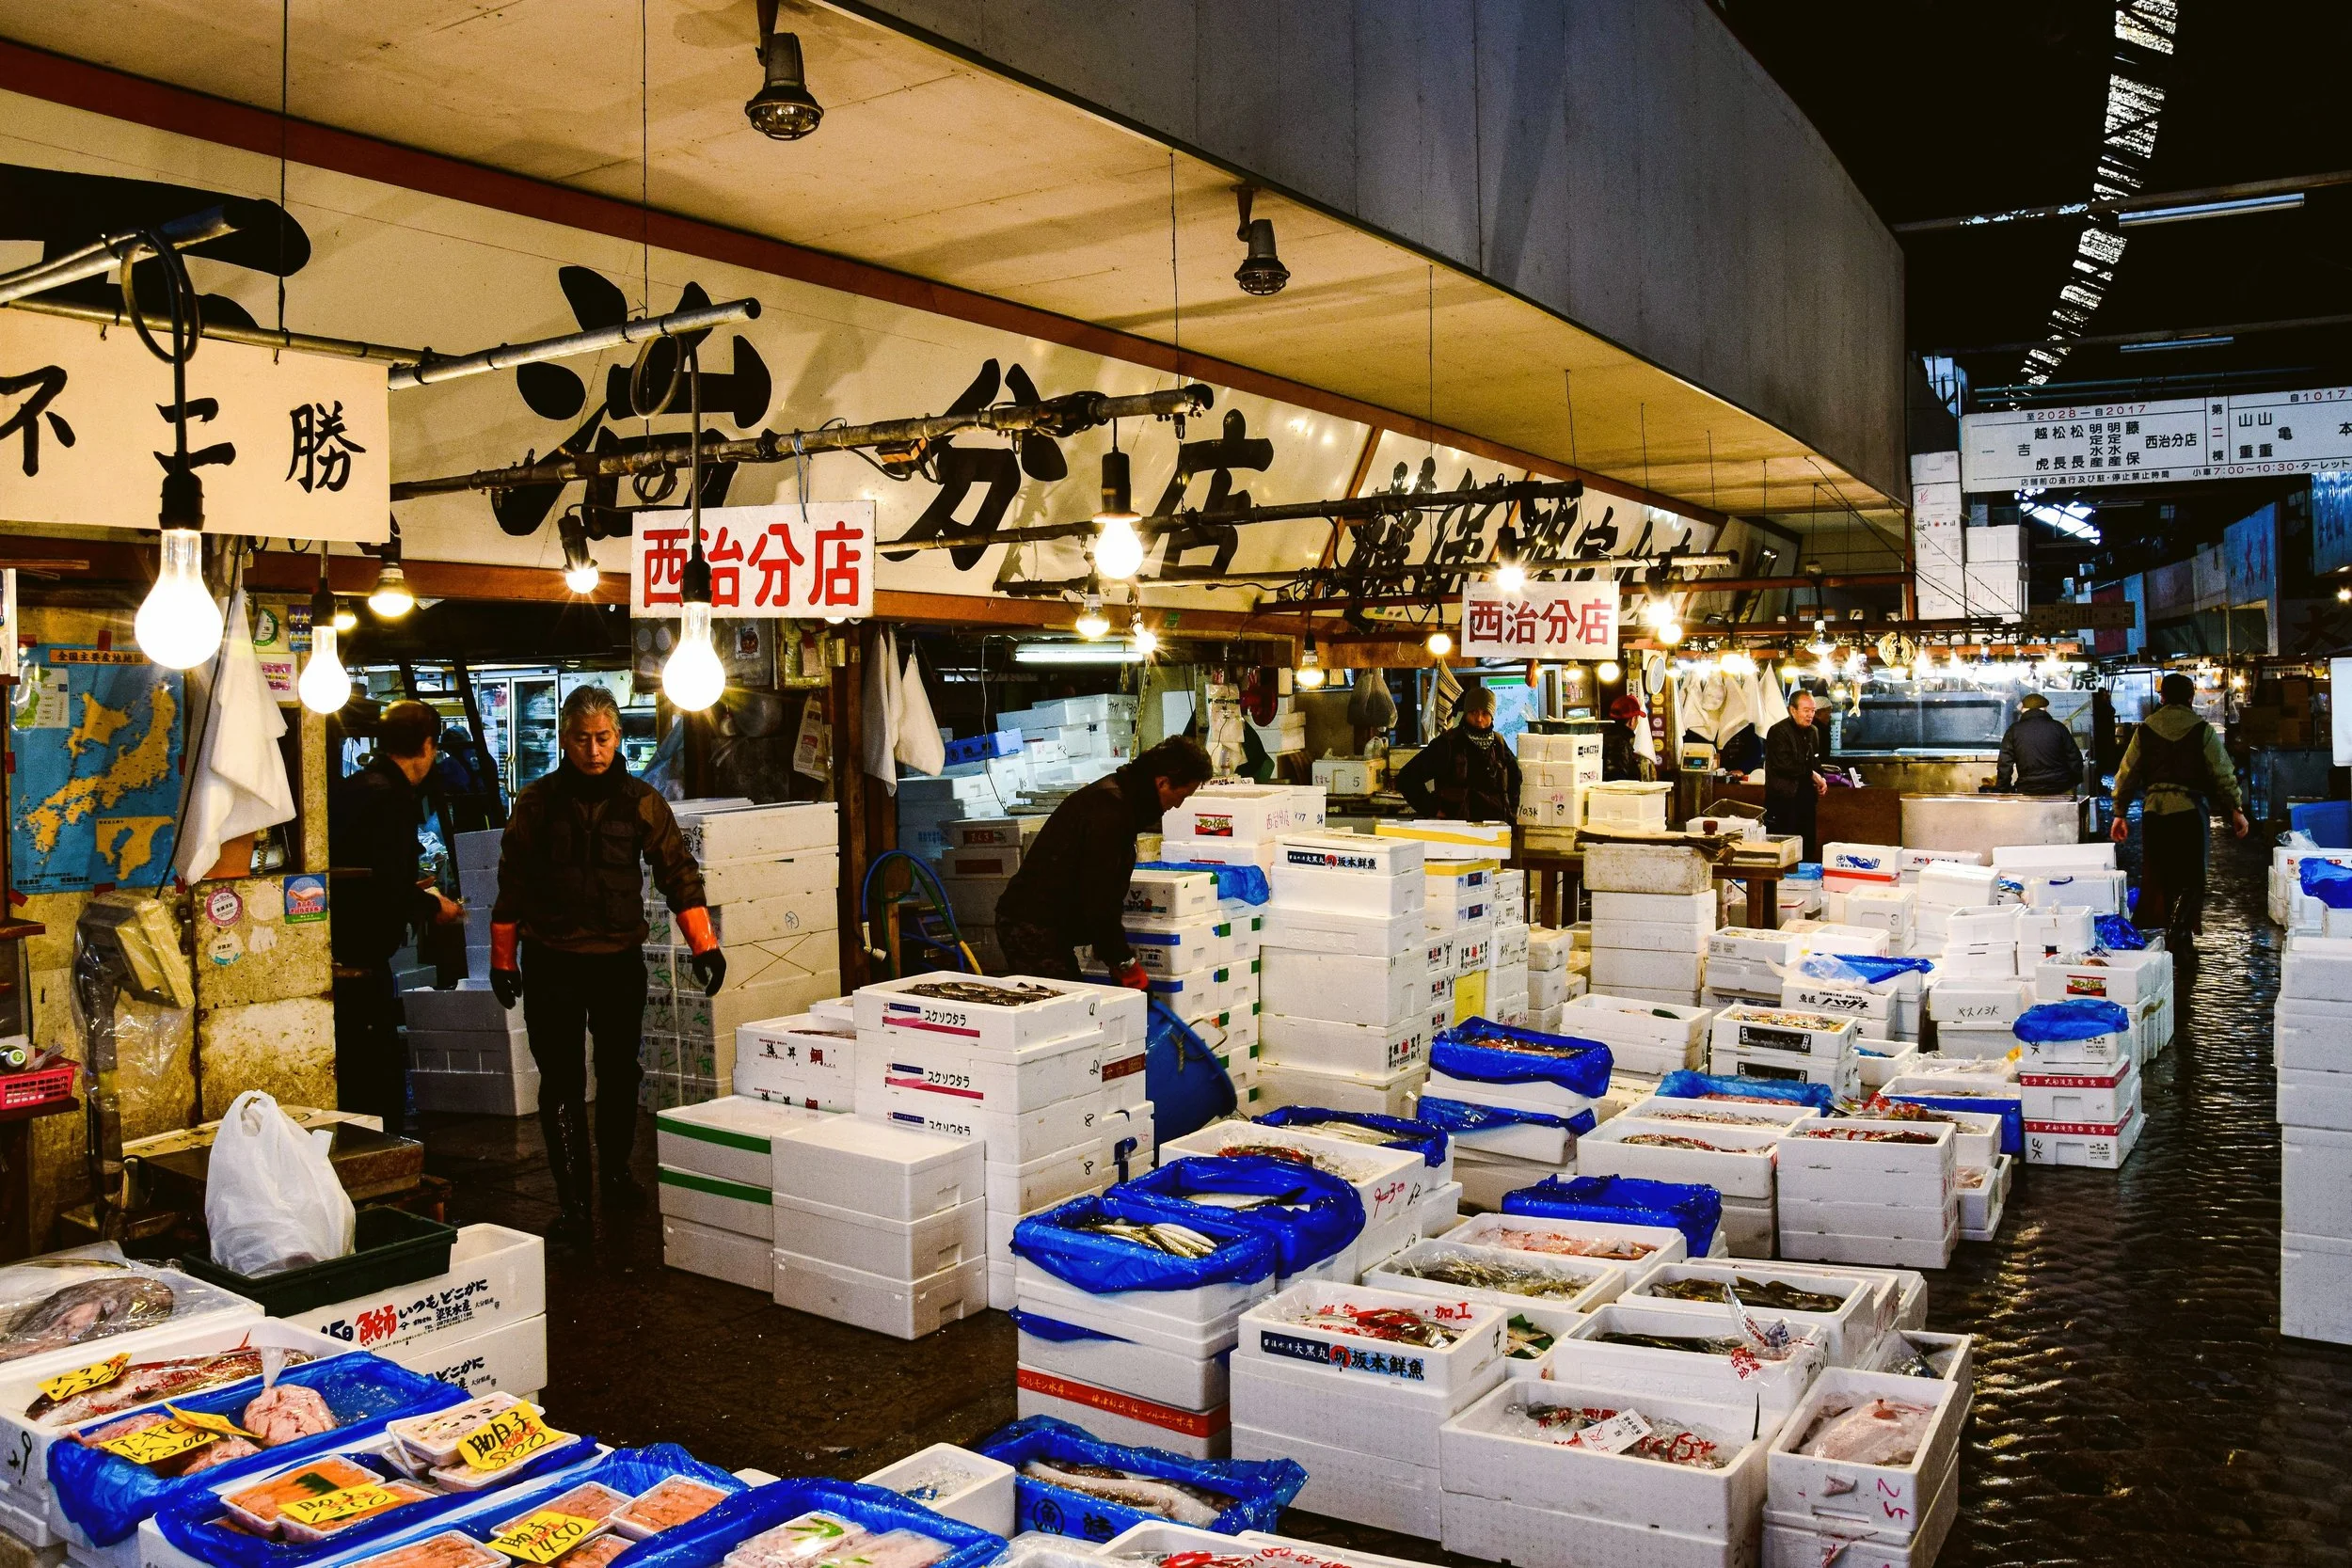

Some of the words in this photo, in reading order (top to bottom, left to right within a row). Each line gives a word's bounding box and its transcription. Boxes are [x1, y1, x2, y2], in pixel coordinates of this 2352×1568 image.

[2089, 423, 2104, 467] 明定水産
[2107, 421, 2122, 467] 明定水産
[2145, 433, 2198, 450] 西治分店
[2212, 404, 2224, 461] 第二棟
[644, 521, 862, 608] 西治分店
[1469, 598, 1613, 644] 西治分店
[1337, 856, 1376, 869] 坂本鮮魚
[925, 1009, 967, 1027] スケソウタラ
[929, 1070, 970, 1088] スケソウタラ
[355, 1305, 397, 1347] 鰤
[1435, 1302, 1472, 1320] 加工
[1295, 1342, 1328, 1360] 大黒丸
[1351, 1354, 1424, 1381] 坂本鮮魚
